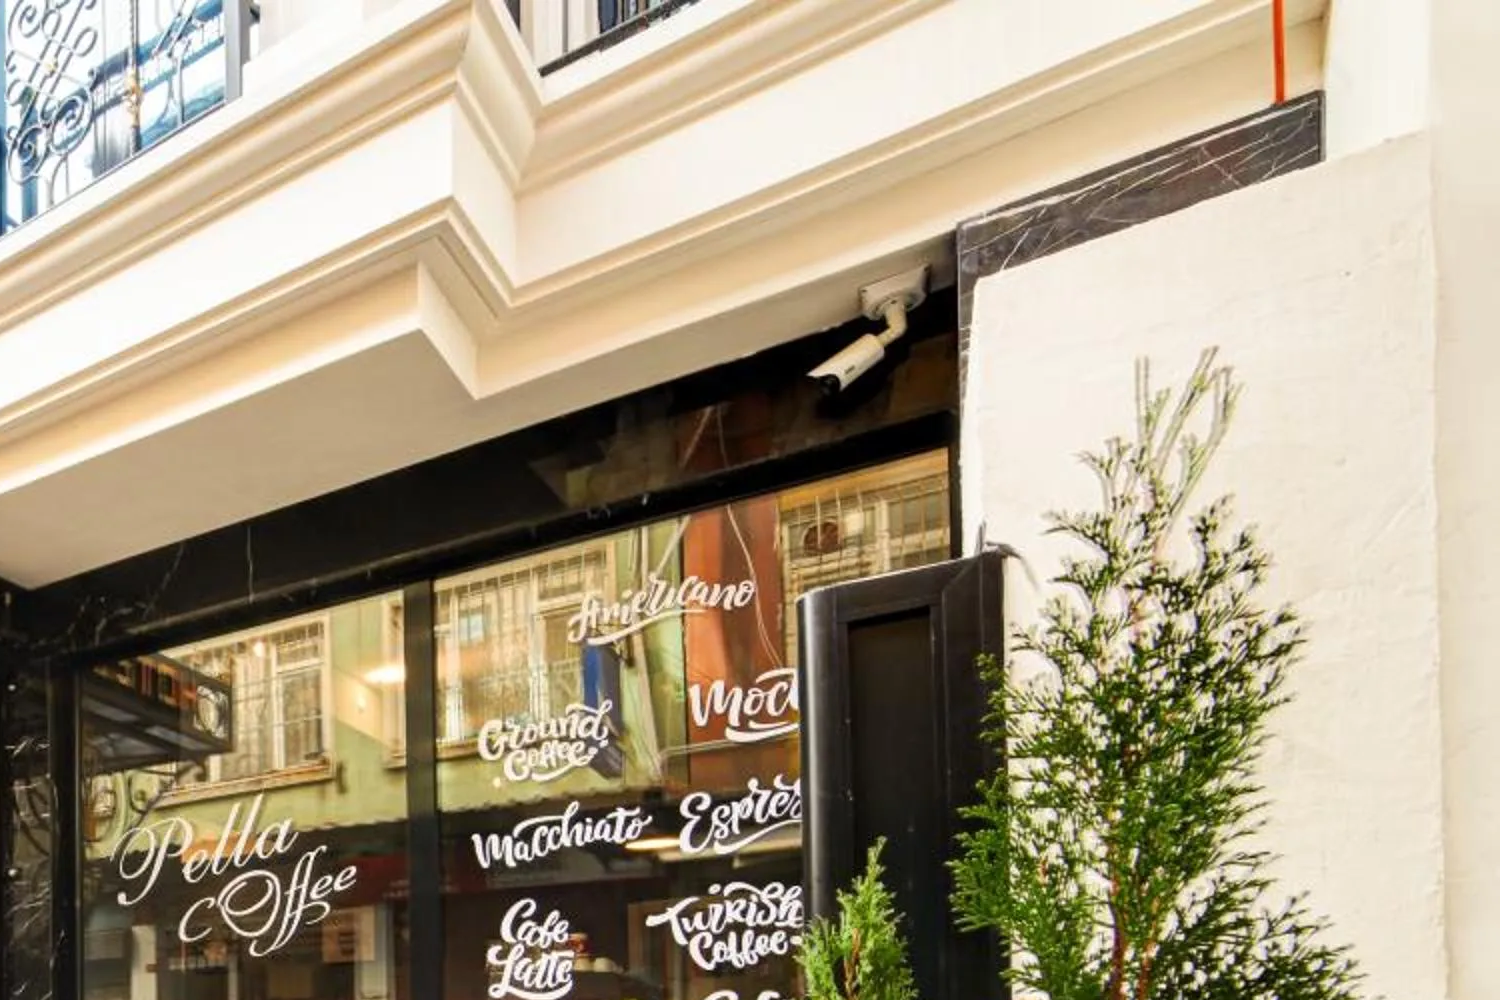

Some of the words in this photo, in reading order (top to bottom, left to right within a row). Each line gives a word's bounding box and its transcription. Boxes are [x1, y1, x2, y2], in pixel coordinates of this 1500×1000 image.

[567, 573, 756, 643] Americano
[478, 700, 613, 760] Ground
[503, 739, 601, 782] Coffee
[110, 794, 299, 905] Pella
[472, 801, 652, 868] Macchiato
[487, 944, 575, 1000] Latte
[688, 929, 790, 972] Coffee
